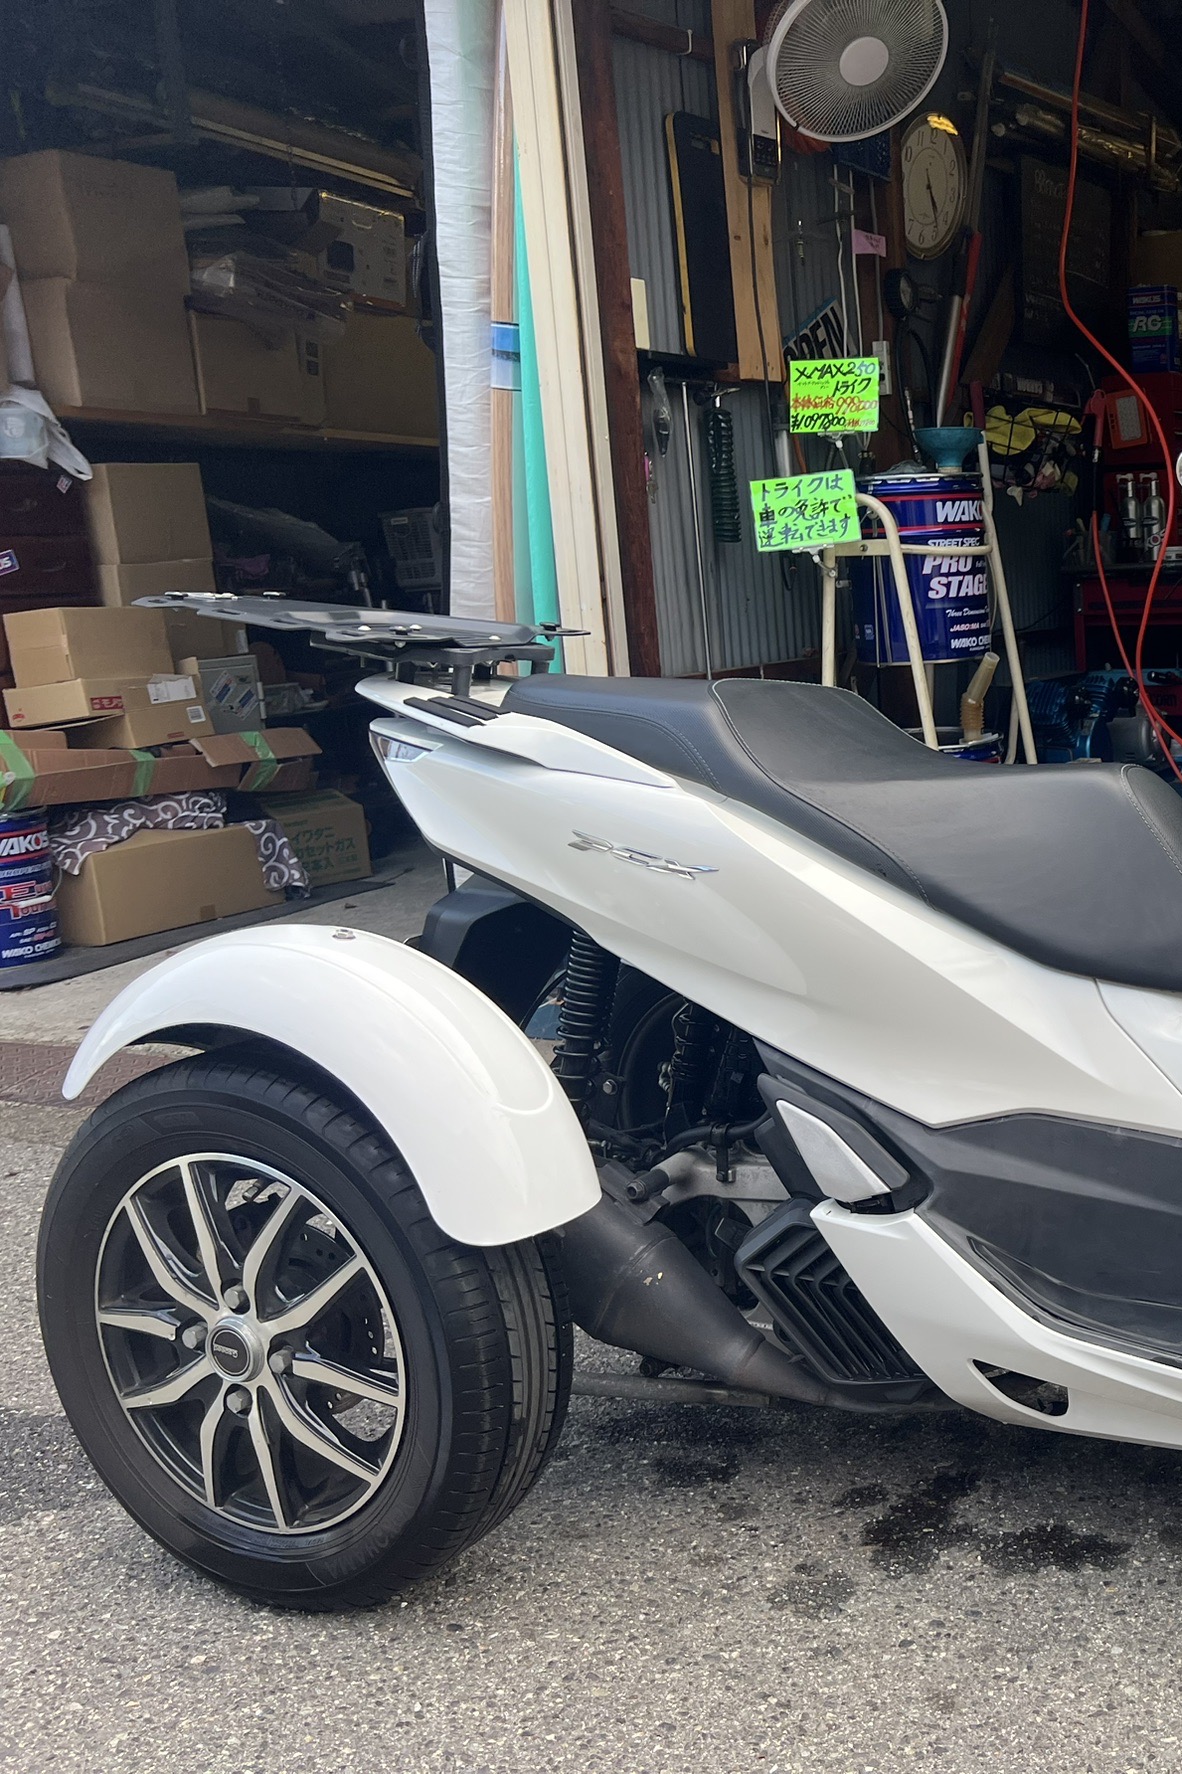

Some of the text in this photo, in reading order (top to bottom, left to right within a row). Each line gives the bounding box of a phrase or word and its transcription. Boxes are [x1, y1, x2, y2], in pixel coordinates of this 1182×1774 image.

[1133, 315, 1163, 333] RG
[832, 377, 872, 398] トライク
[762, 473, 844, 502] トライクは
[759, 494, 853, 528] 車の免許で
[758, 513, 851, 548] 運転できます
[922, 554, 973, 575] PRO
[951, 637, 978, 649] WAKO
